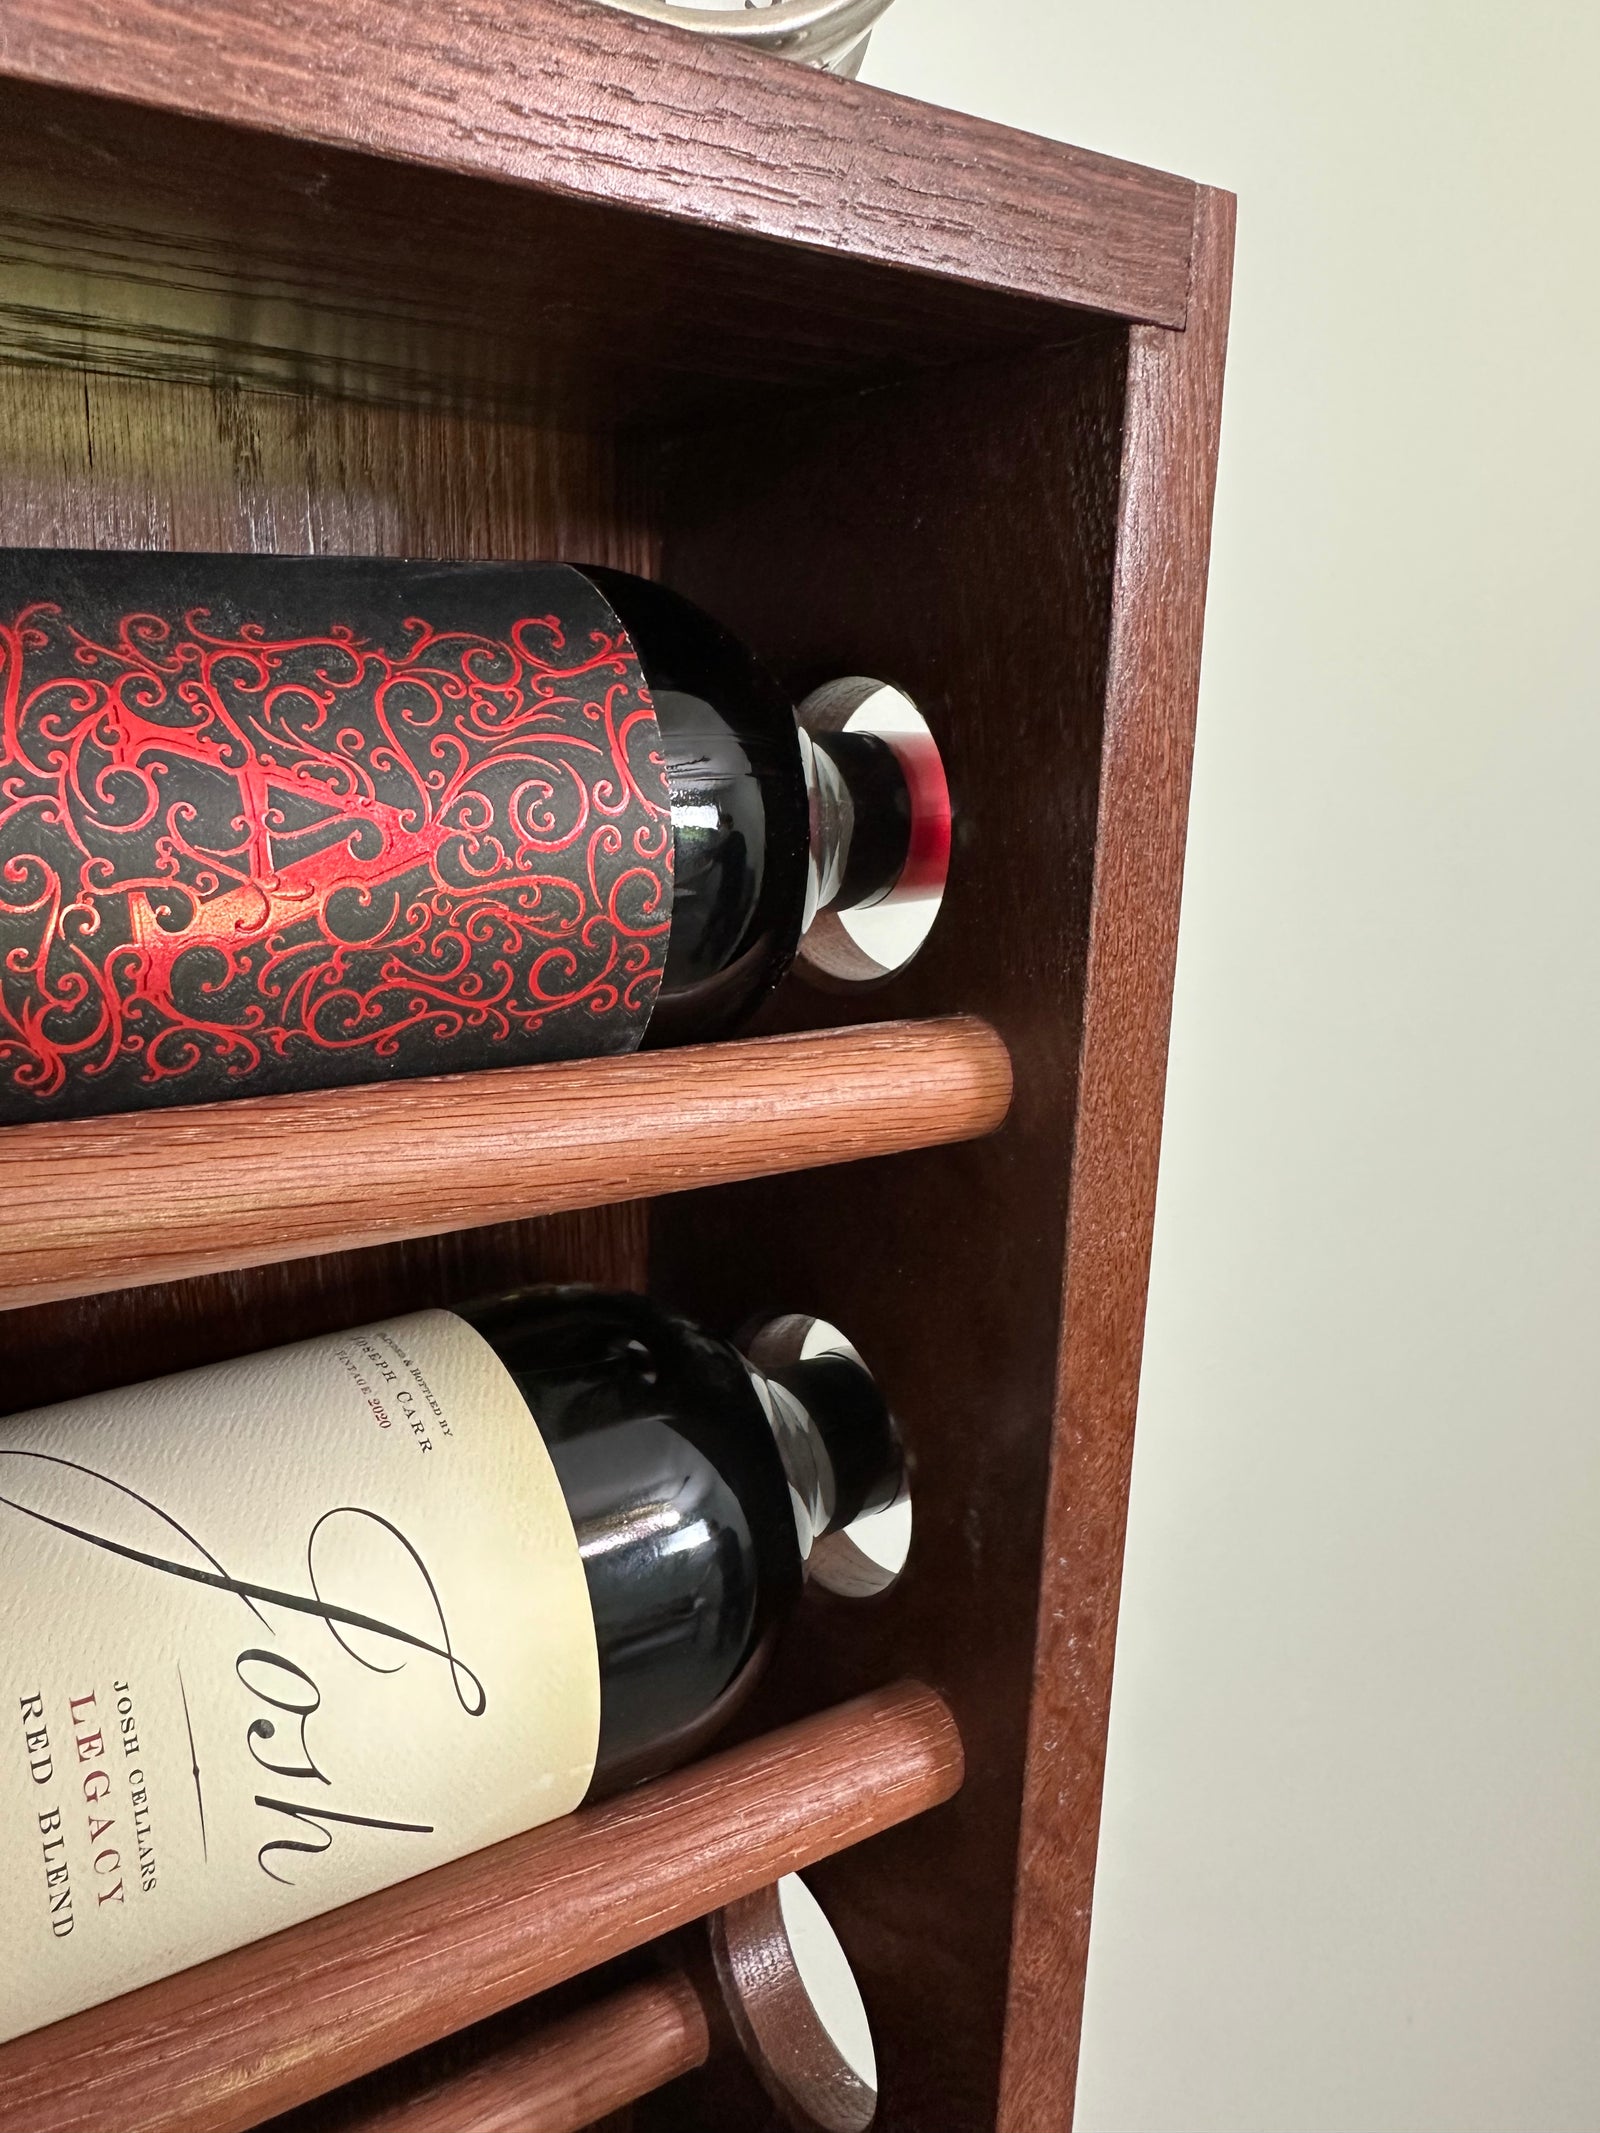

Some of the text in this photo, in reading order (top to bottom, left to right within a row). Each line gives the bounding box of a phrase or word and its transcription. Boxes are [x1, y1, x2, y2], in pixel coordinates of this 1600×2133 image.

[335, 1350, 392, 1429] VINTAGE 2020
[351, 1336, 397, 1383] JOSEPH
[396, 1391, 432, 1453] CARR
[410, 1367, 442, 1416] BOTTLED
[439, 1419, 454, 1437] BY
[0, 1450, 486, 1886] Josh
[20, 1690, 75, 1938] RED BLEND
[69, 1688, 124, 1907] LEGACY
[113, 1680, 157, 1892] JOSH CELLARS
